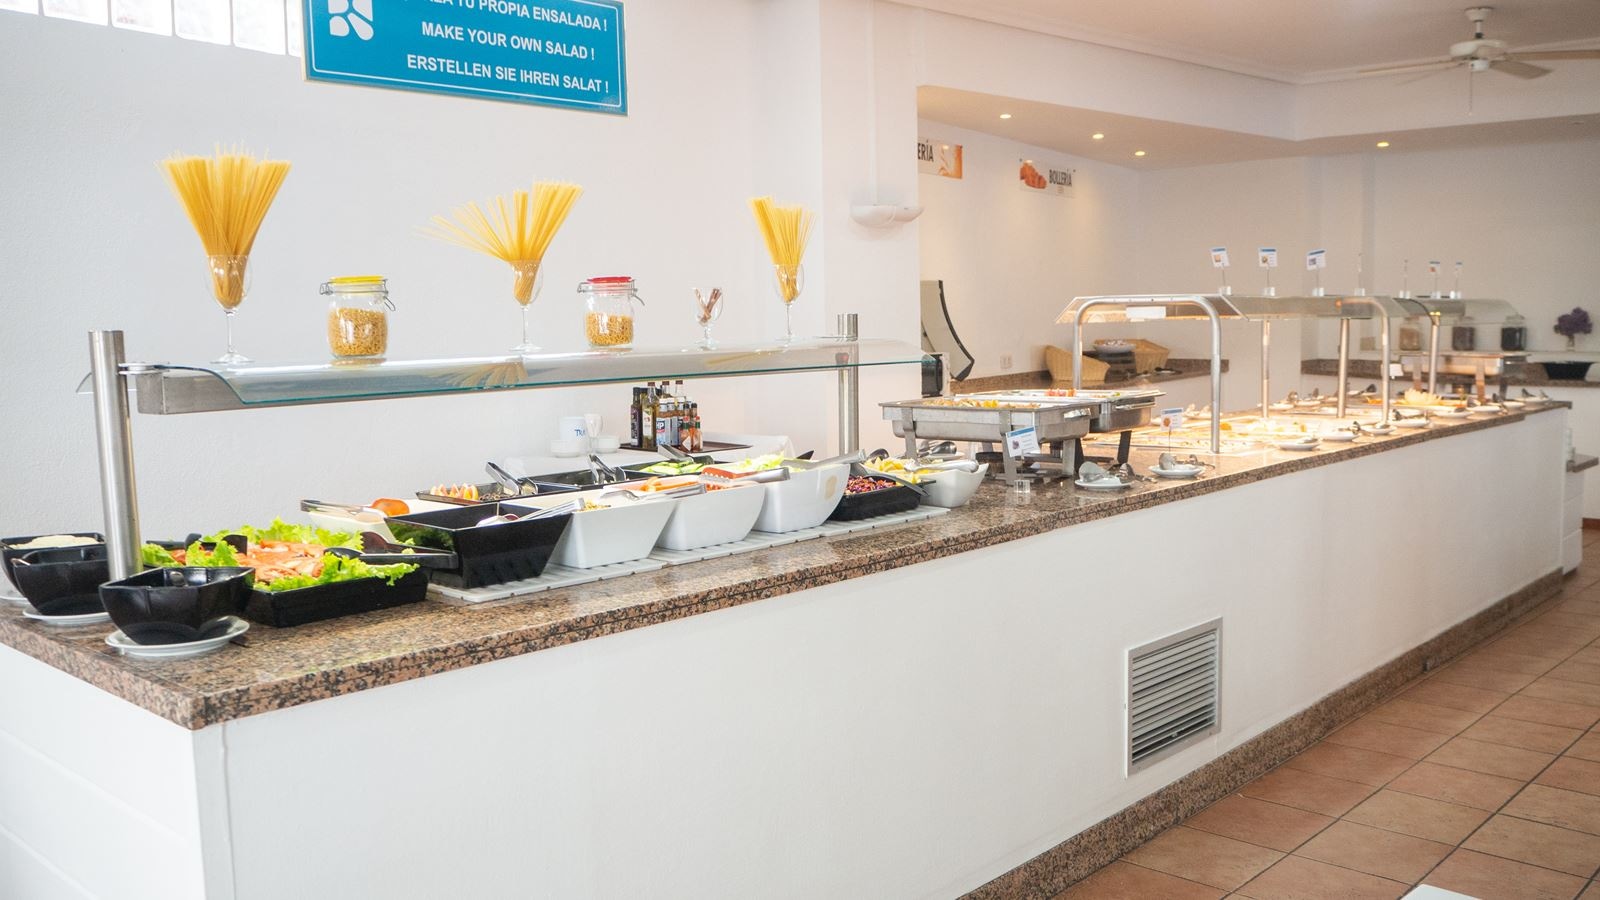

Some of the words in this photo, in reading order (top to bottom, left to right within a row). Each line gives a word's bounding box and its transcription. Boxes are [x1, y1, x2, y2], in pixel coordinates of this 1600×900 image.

[478, 0, 530, 19] PROPIA
[532, 6, 601, 31] ENSALADA
[602, 19, 607, 32] !
[421, 21, 465, 41] MAKE
[467, 28, 507, 48] YOUR
[510, 35, 542, 53] OWN
[545, 41, 588, 60] SALAD
[590, 47, 595, 60] !
[407, 54, 492, 78] ERSTELLEN
[495, 65, 517, 82] SIE
[520, 69, 560, 87] IHREN
[562, 75, 602, 93] SALAT
[604, 80, 609, 94] !
